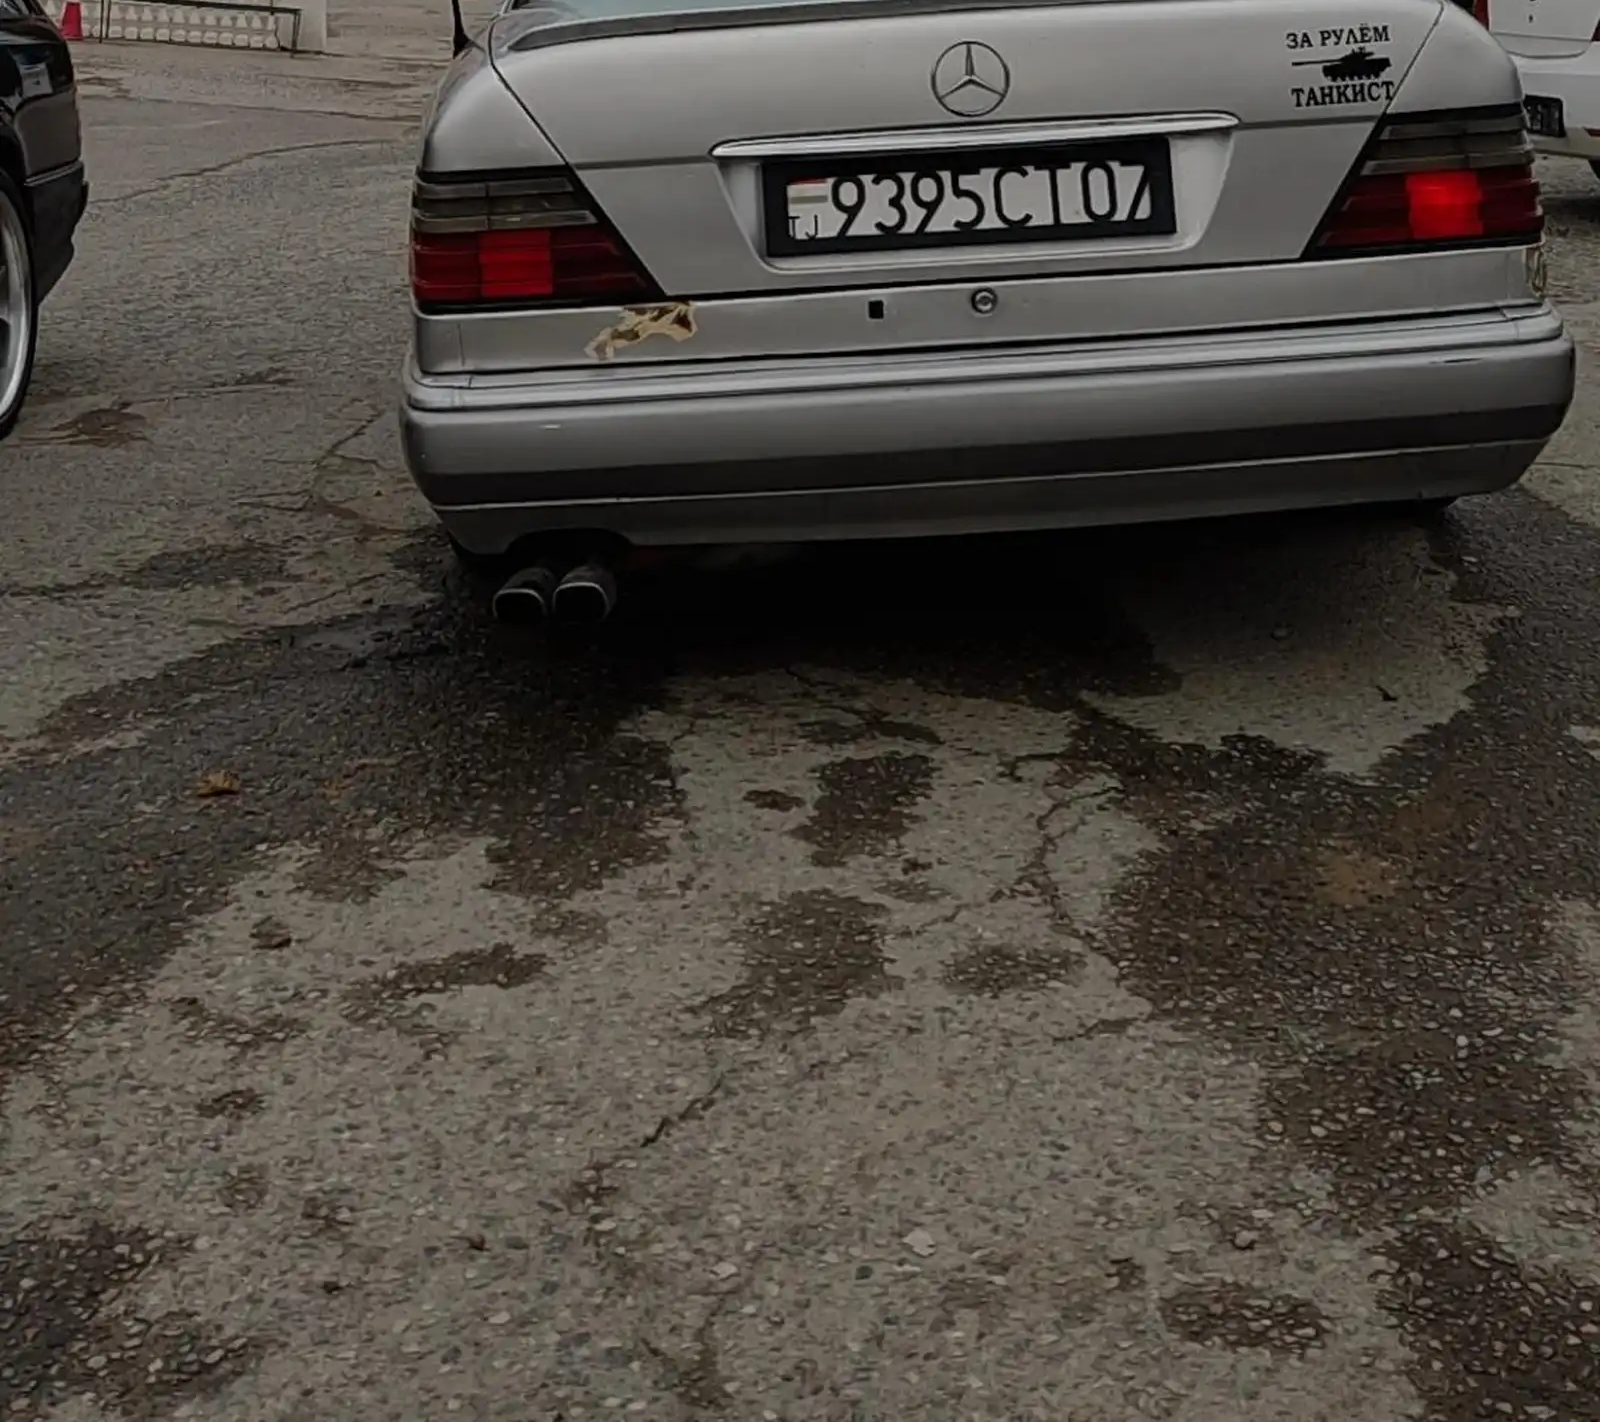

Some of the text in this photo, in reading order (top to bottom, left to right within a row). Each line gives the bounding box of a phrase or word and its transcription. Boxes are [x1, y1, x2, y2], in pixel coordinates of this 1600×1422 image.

[1286, 23, 1390, 49] ЗА РУЛЁМ
[1291, 81, 1395, 108] ТАНКИСТ
[788, 215, 819, 240] TJ
